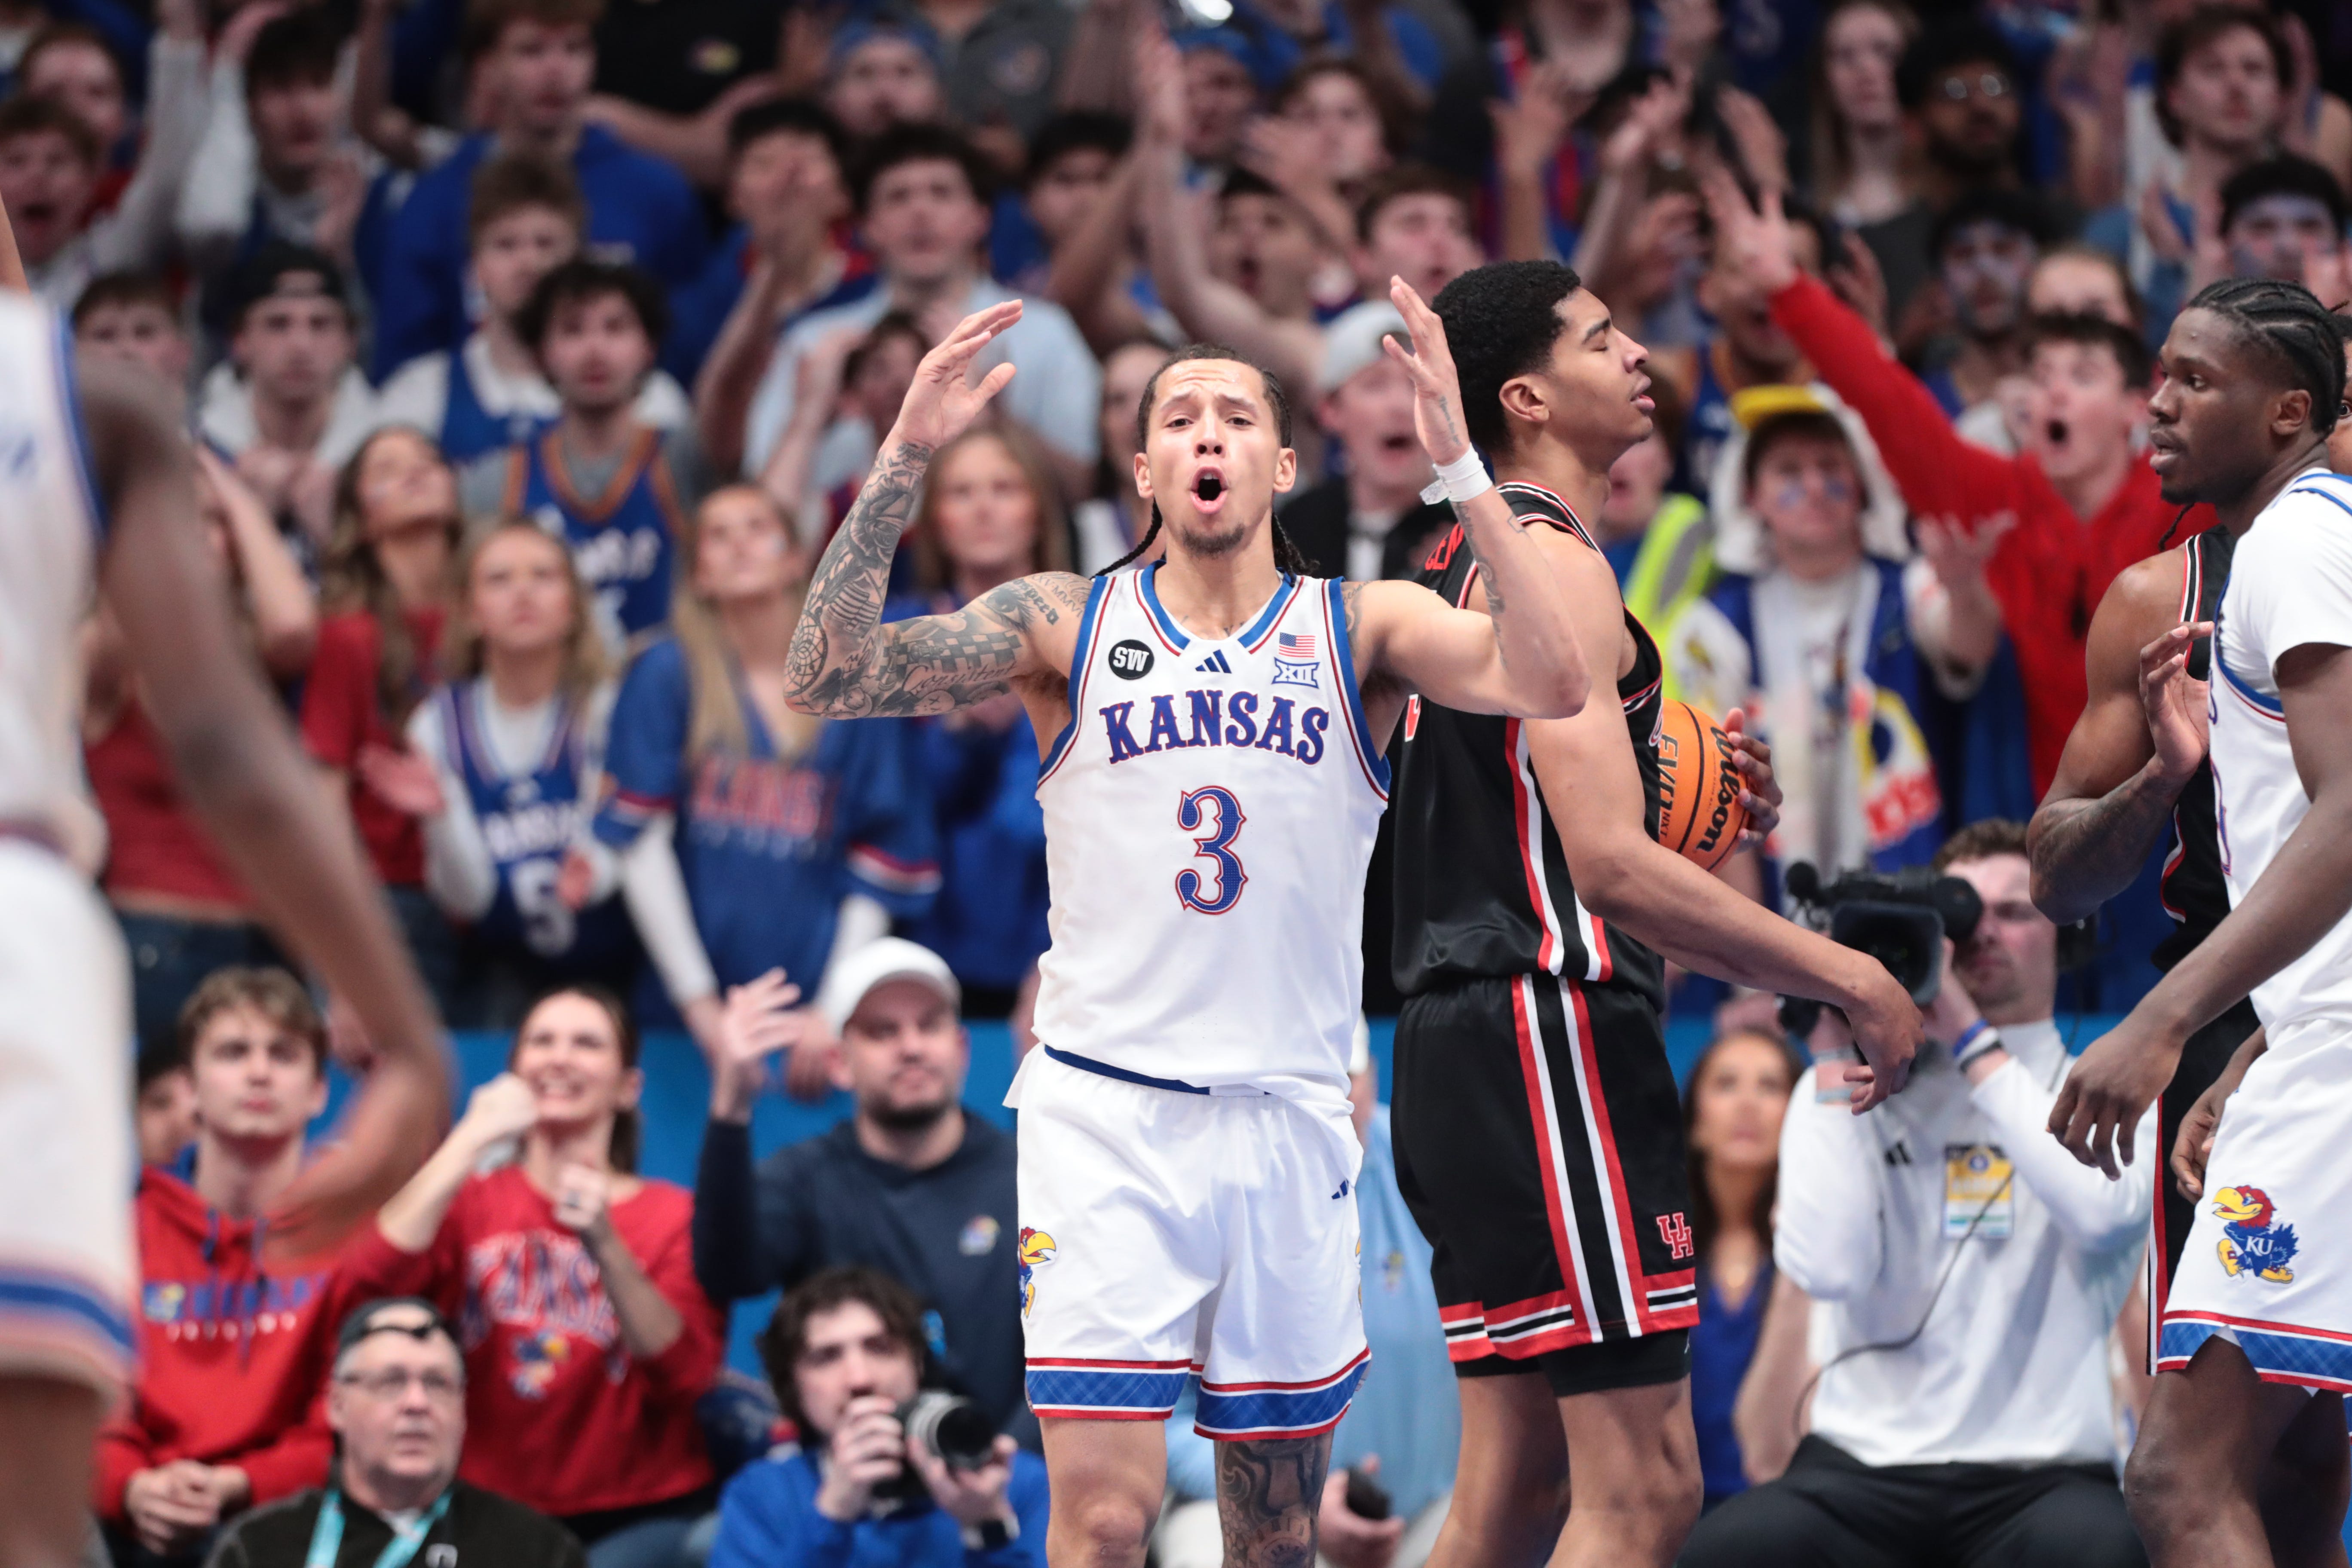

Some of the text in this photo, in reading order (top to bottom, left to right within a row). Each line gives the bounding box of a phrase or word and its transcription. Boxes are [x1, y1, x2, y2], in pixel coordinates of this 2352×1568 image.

[1112, 646, 1150, 672] SW
[1271, 657, 1320, 689] XII
[1099, 689, 1329, 765] KANSAS
[1175, 785, 1249, 916] 3
[1656, 1212, 1694, 1260] UH
[2245, 1235, 2275, 1256] KU
